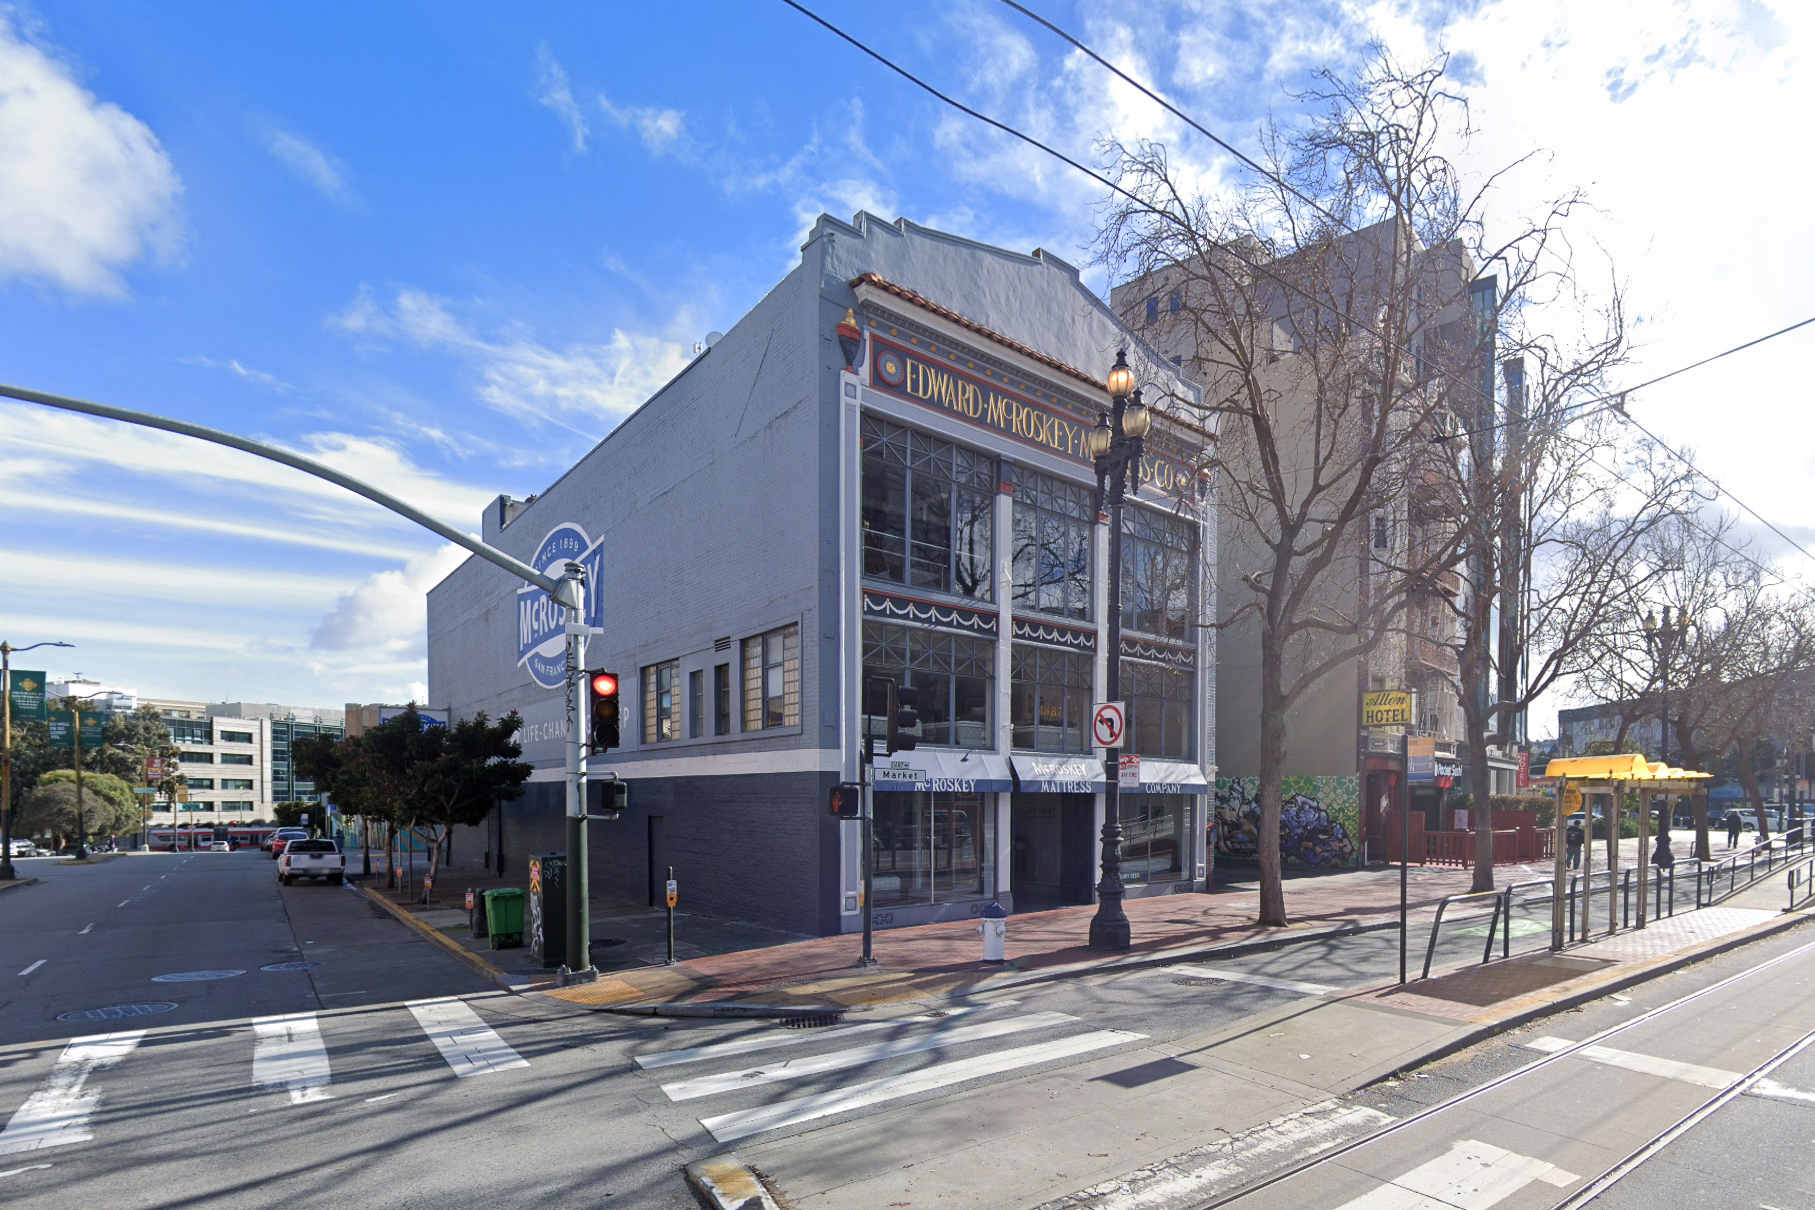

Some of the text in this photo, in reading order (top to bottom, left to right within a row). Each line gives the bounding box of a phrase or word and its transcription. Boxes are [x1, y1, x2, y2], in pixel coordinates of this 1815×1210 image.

[906, 358, 982, 418] EDWARD
[1155, 460, 1174, 490] CO
[559, 538, 579, 552] 1899
[534, 658, 545, 673] SAN
[1366, 692, 1406, 706] Allen
[1366, 708, 1408, 723] HOTEL
[882, 770, 918, 780] Market
[1031, 761, 1087, 776] McROSKEY
[1041, 781, 1092, 793] MATTRESS
[1145, 783, 1181, 794] COMPANY
